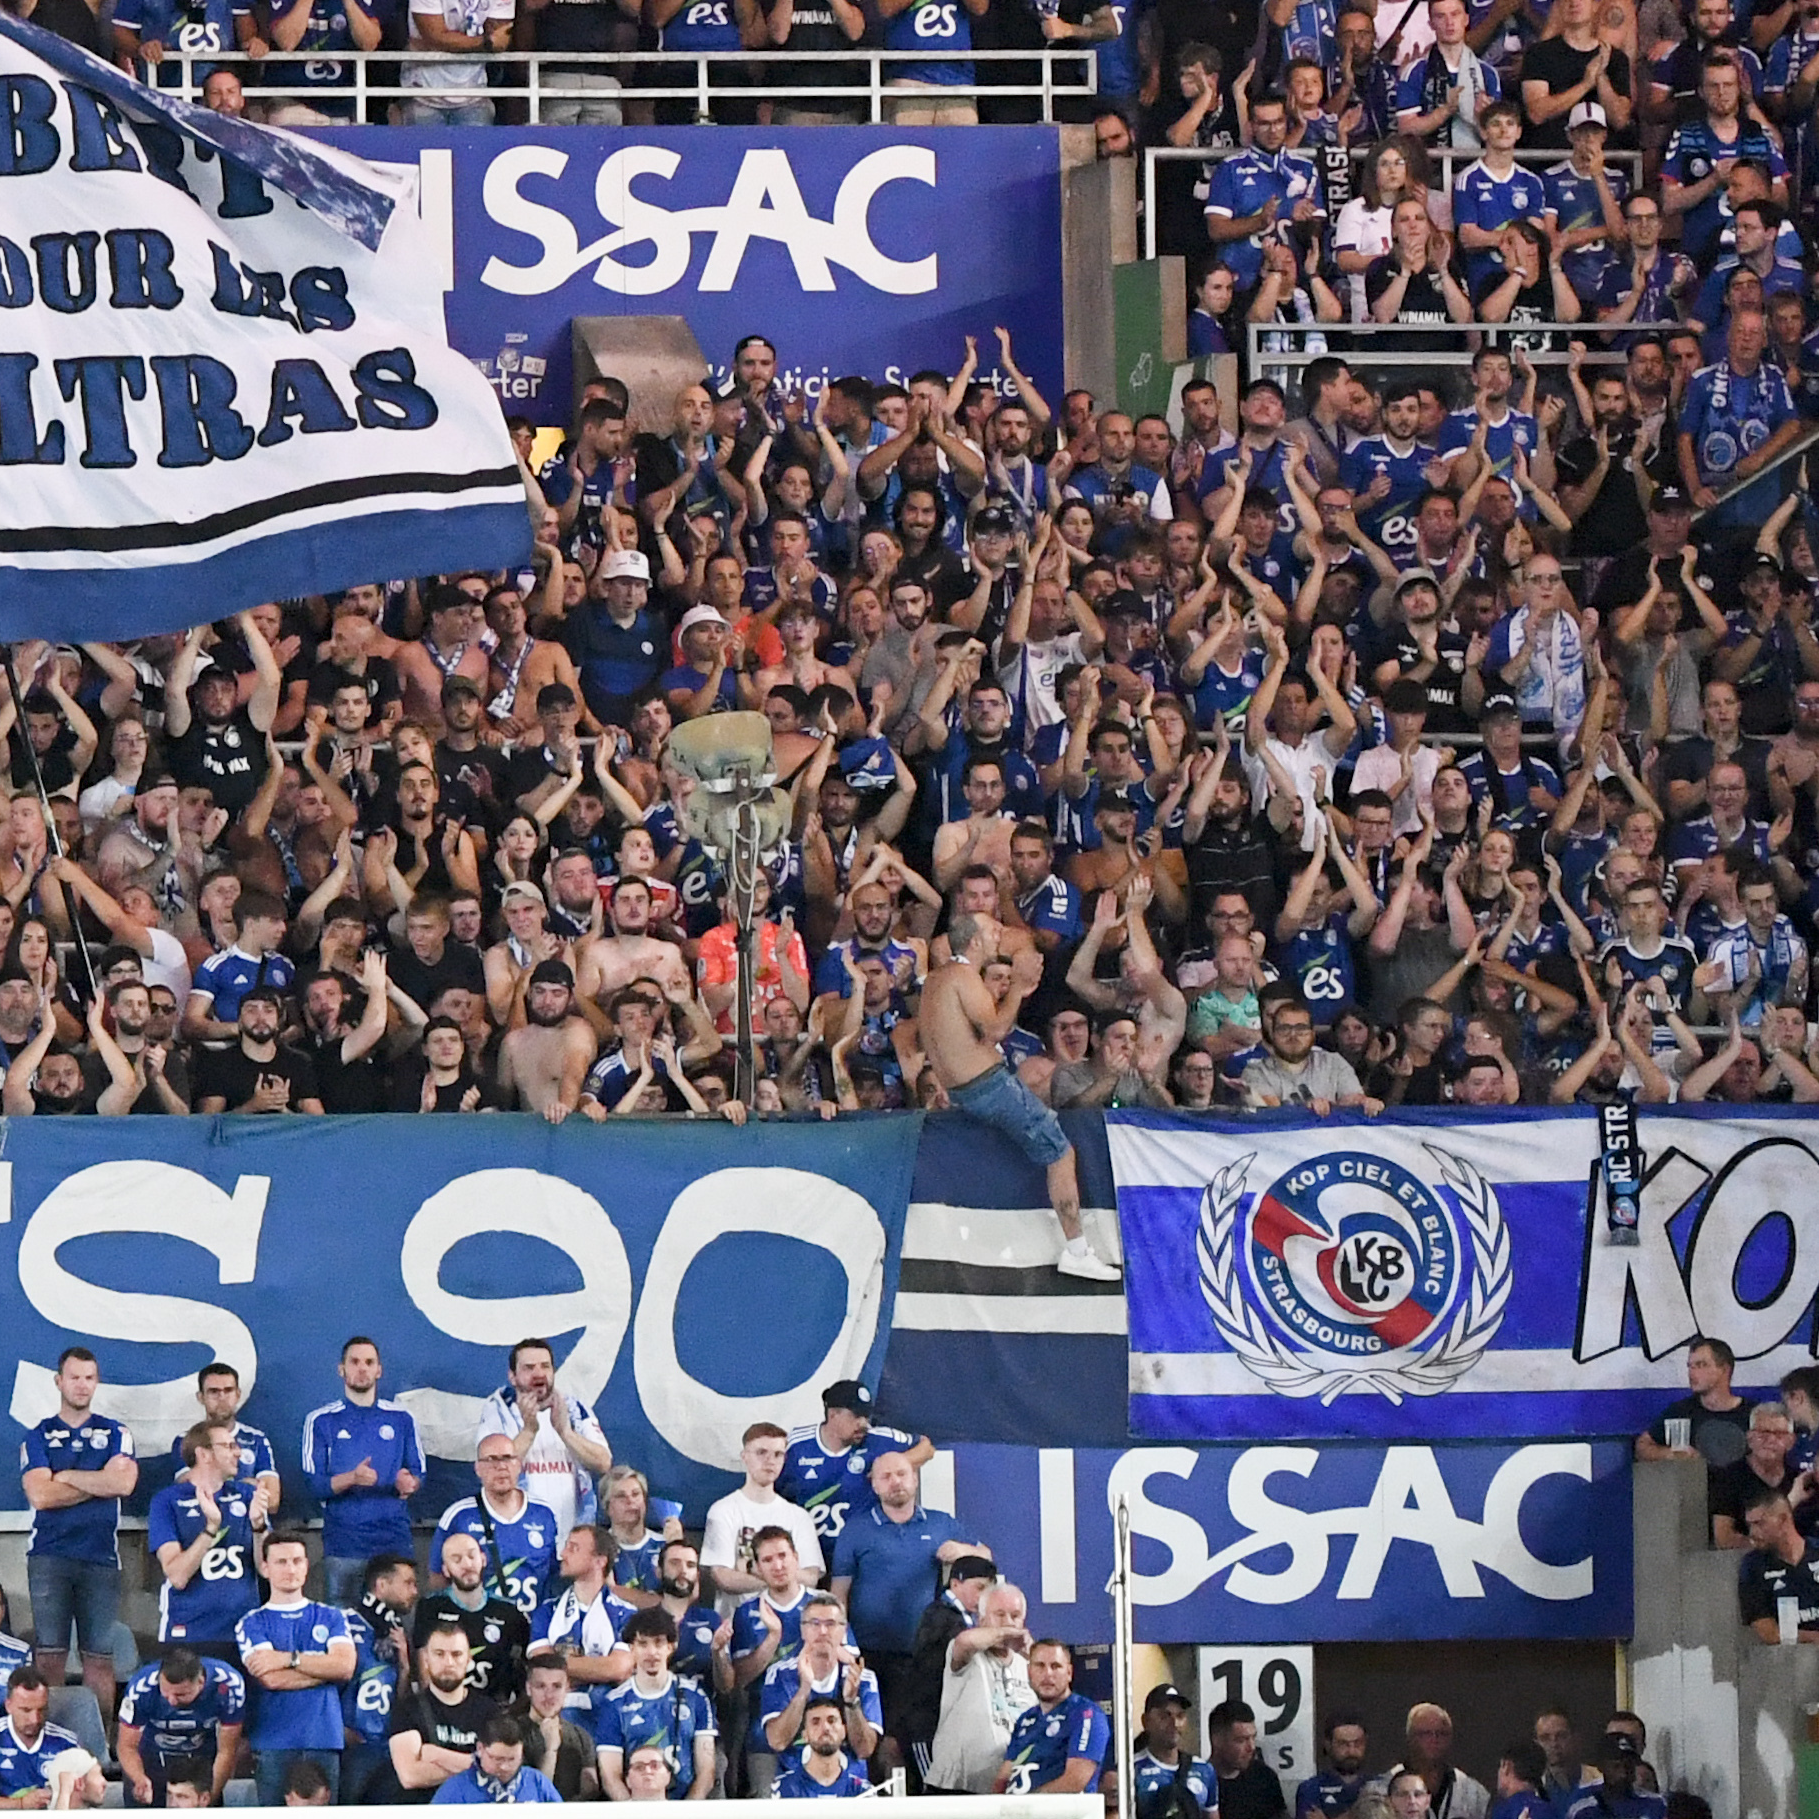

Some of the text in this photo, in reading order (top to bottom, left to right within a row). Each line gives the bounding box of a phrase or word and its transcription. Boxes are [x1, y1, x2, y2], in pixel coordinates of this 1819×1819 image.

[179, 23, 220, 52] es
[915, 4, 956, 37] es
[418, 144, 939, 296] ISSAC
[1304, 968, 1345, 999] es
[1285, 1160, 1447, 1296] KOP CIEL ET BLANC
[1572, 1136, 1819, 1365] KO
[399, 1165, 890, 1471] 90
[1262, 1254, 1383, 1353] STRASBOURG
[813, 1502, 849, 1537] es
[921, 1443, 1594, 1606] ISSAC
[201, 1546, 243, 1579] es
[361, 1681, 391, 1713] es
[1211, 1658, 1302, 1735] 19
